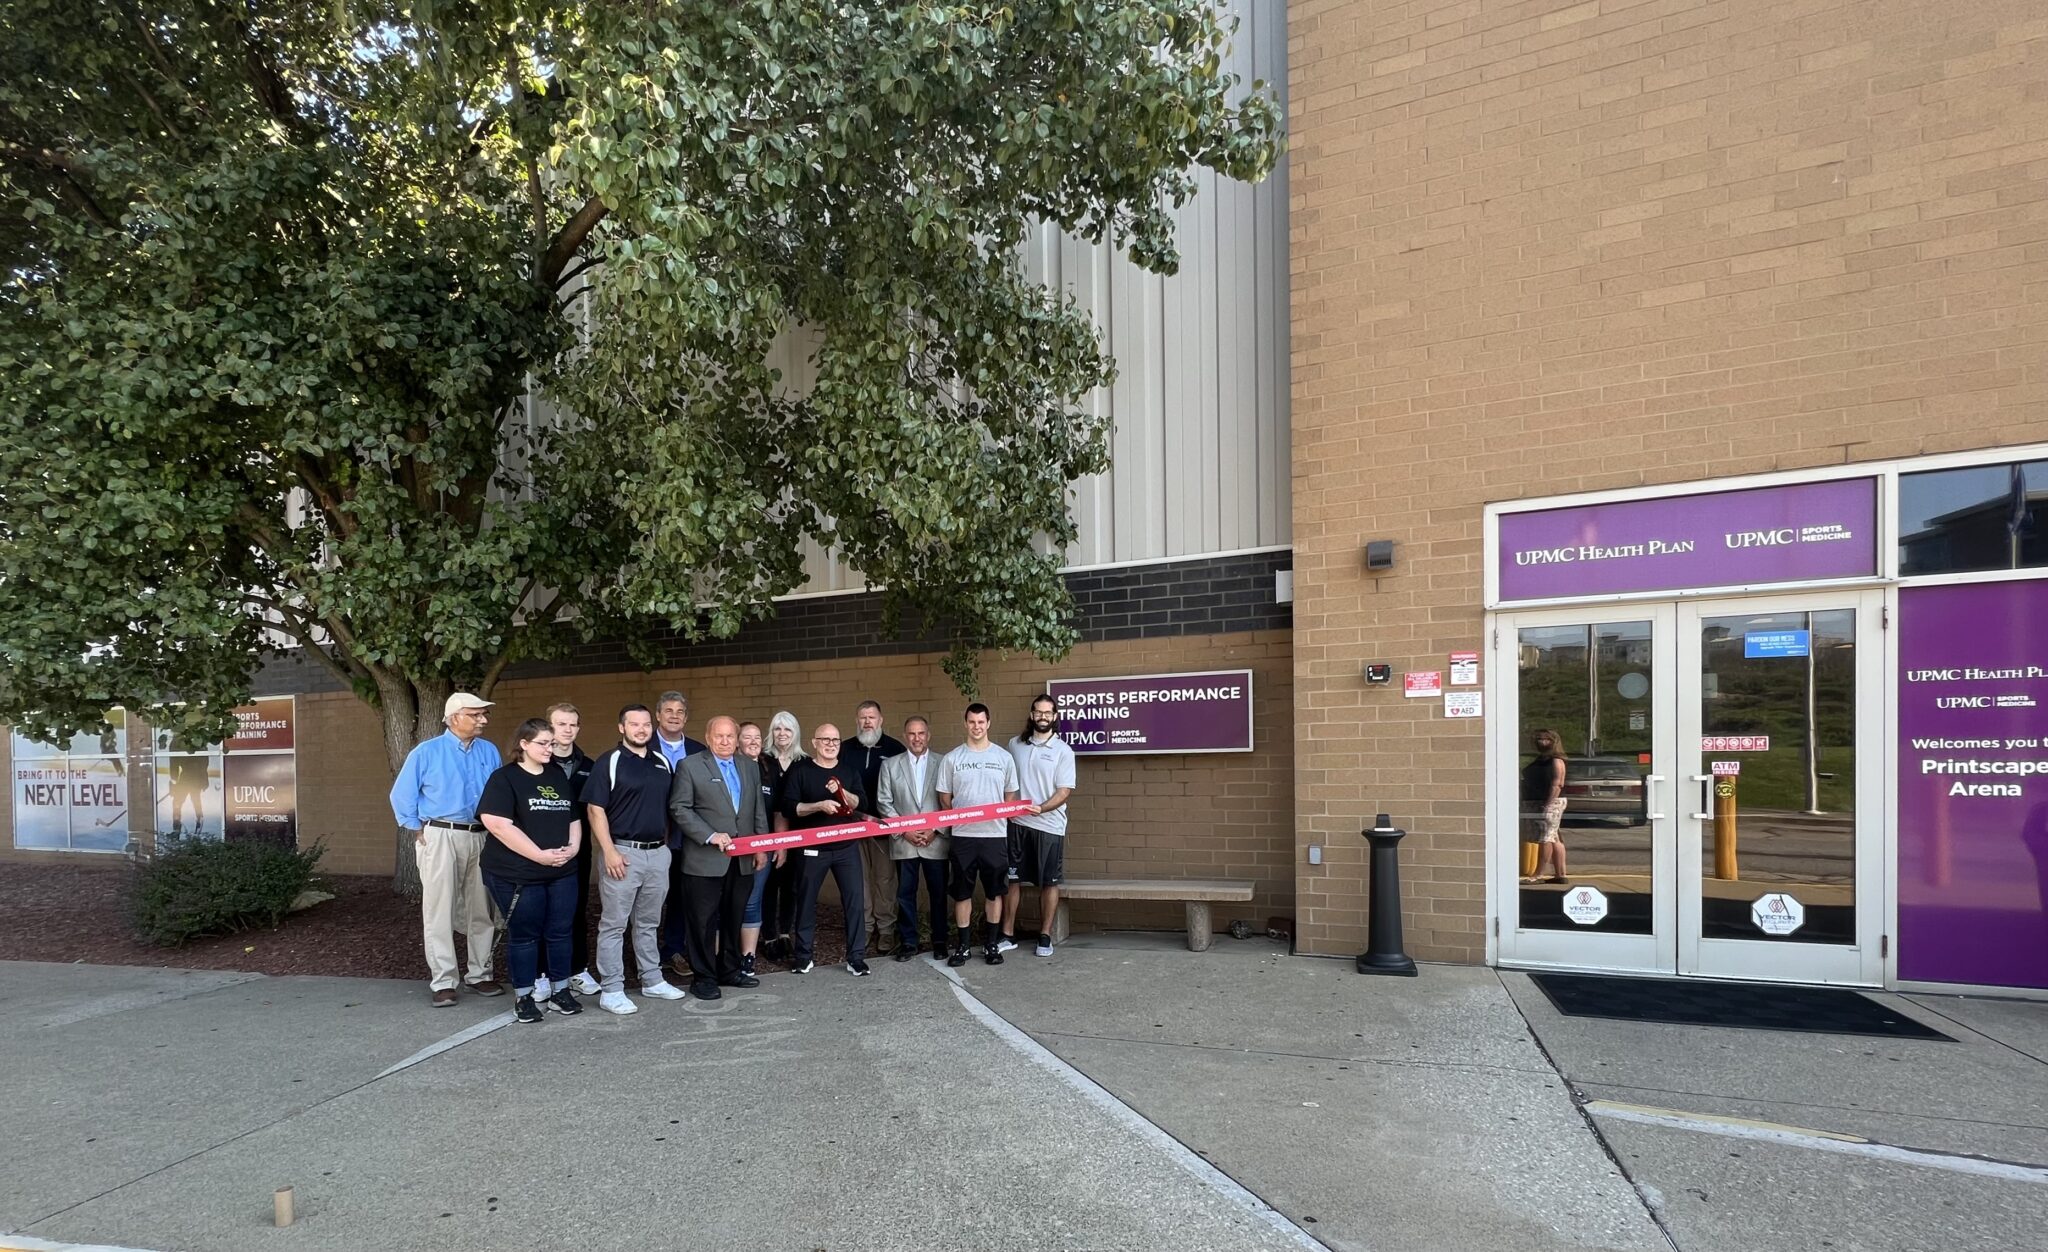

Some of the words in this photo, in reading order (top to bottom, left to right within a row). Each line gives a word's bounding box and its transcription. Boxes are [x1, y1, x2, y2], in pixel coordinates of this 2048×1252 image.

[1802, 525, 1842, 534] SPORTS
[1725, 528, 1793, 548] UPMC
[1802, 532, 1852, 542] MEDICINE
[1516, 548, 1574, 565] UPMC
[1579, 545, 1643, 560] HEALTH
[1648, 541, 1694, 554] PLAN
[1908, 669, 1961, 682] UPMC
[1965, 668, 2022, 680] HEALTH
[2027, 666, 2048, 678] PL
[1057, 692, 1115, 706] SPORTS
[1119, 686, 1241, 704] PERFORMANCE
[1936, 696, 1991, 708] UPMC
[232, 712, 259, 721] PORTS
[1057, 706, 1130, 720] TRAINING
[237, 720, 287, 730] RFORMANCE
[233, 730, 267, 739] RAINING
[1059, 731, 1106, 745] UPMC
[1111, 736, 1147, 744] MEDICINE
[1912, 738, 2000, 749] Welcomes
[2005, 739, 2037, 750] you
[955, 762, 982, 771] UPMC
[1922, 759, 2048, 776] Printscape
[18, 770, 43, 780] BRING
[45, 770, 53, 780] IT
[56, 770, 67, 780] TO
[70, 770, 87, 780] THE
[233, 785, 275, 803] UPMC
[1949, 781, 2022, 796] Arena
[25, 784, 66, 806] NEXT
[72, 783, 124, 807] LEVEL
[996, 805, 1016, 814] GRAND
[234, 814, 258, 822] SPORTS
[938, 813, 959, 822] GRAND
[960, 810, 985, 819] OPENING
[900, 818, 927, 827] OPENING
[816, 830, 839, 838] GRAND
[839, 825, 867, 835] OPENING
[750, 839, 774, 848] GRAND
[774, 835, 803, 845] OPENING
